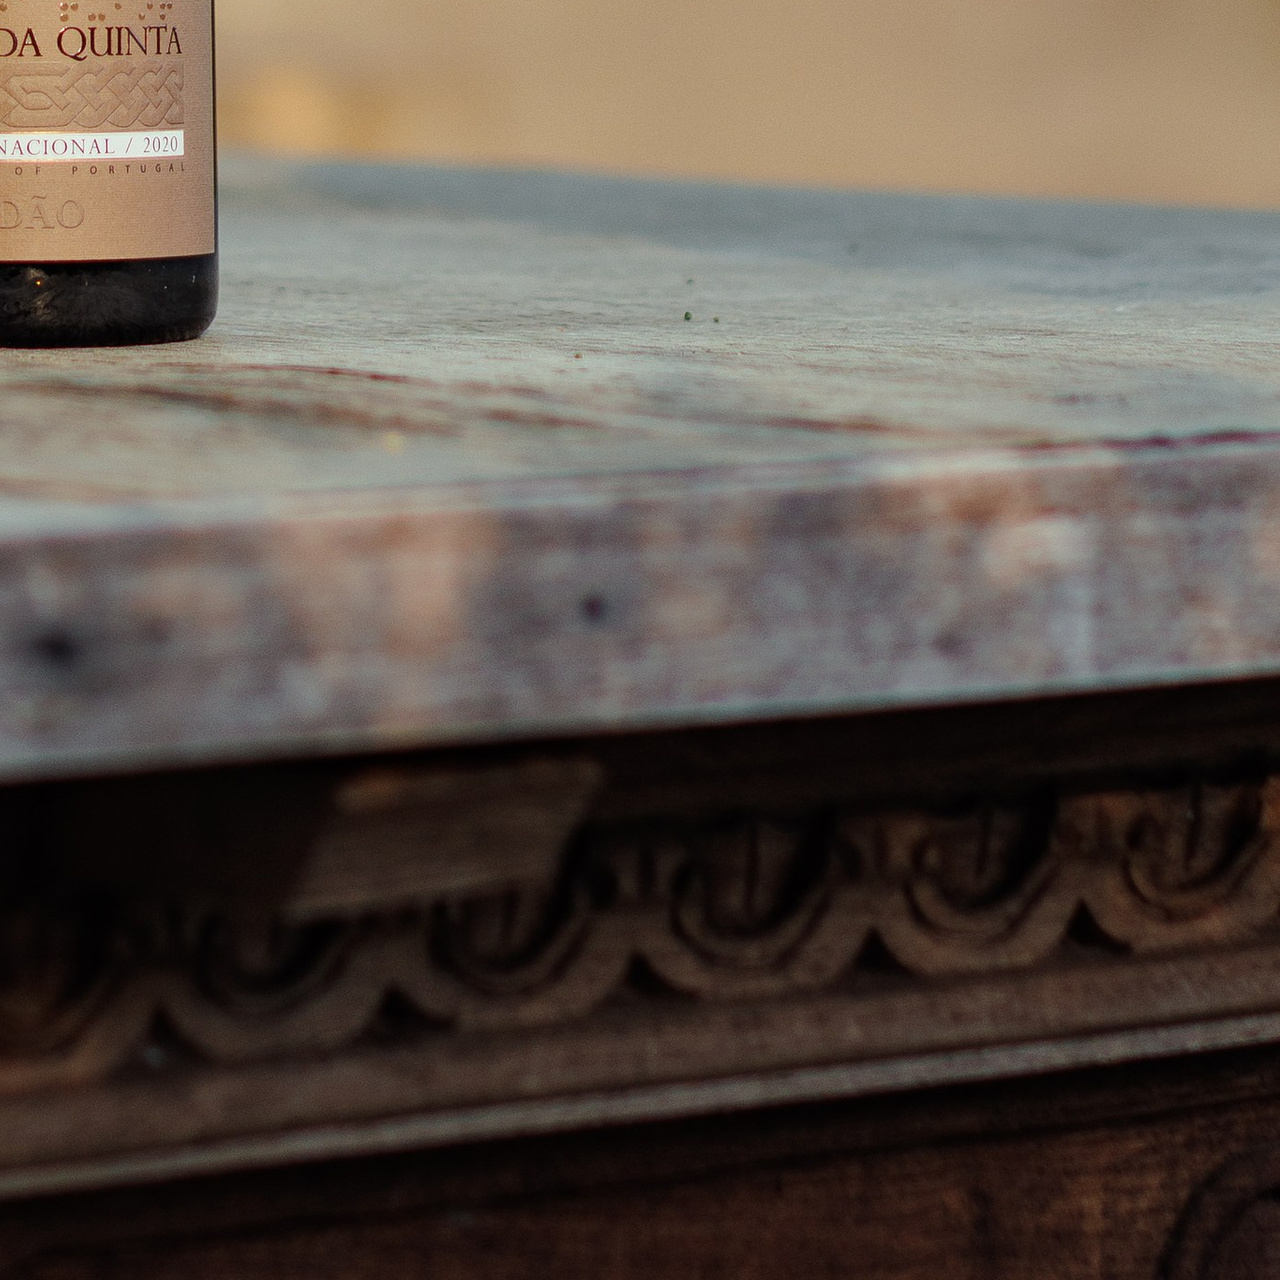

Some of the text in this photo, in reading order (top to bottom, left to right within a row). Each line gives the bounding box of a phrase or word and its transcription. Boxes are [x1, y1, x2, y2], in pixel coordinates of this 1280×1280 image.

[56, 24, 183, 62] QUINTA
[143, 135, 179, 154] 2020
[14, 166, 42, 176] OF
[72, 162, 185, 176] PORTUGAL
